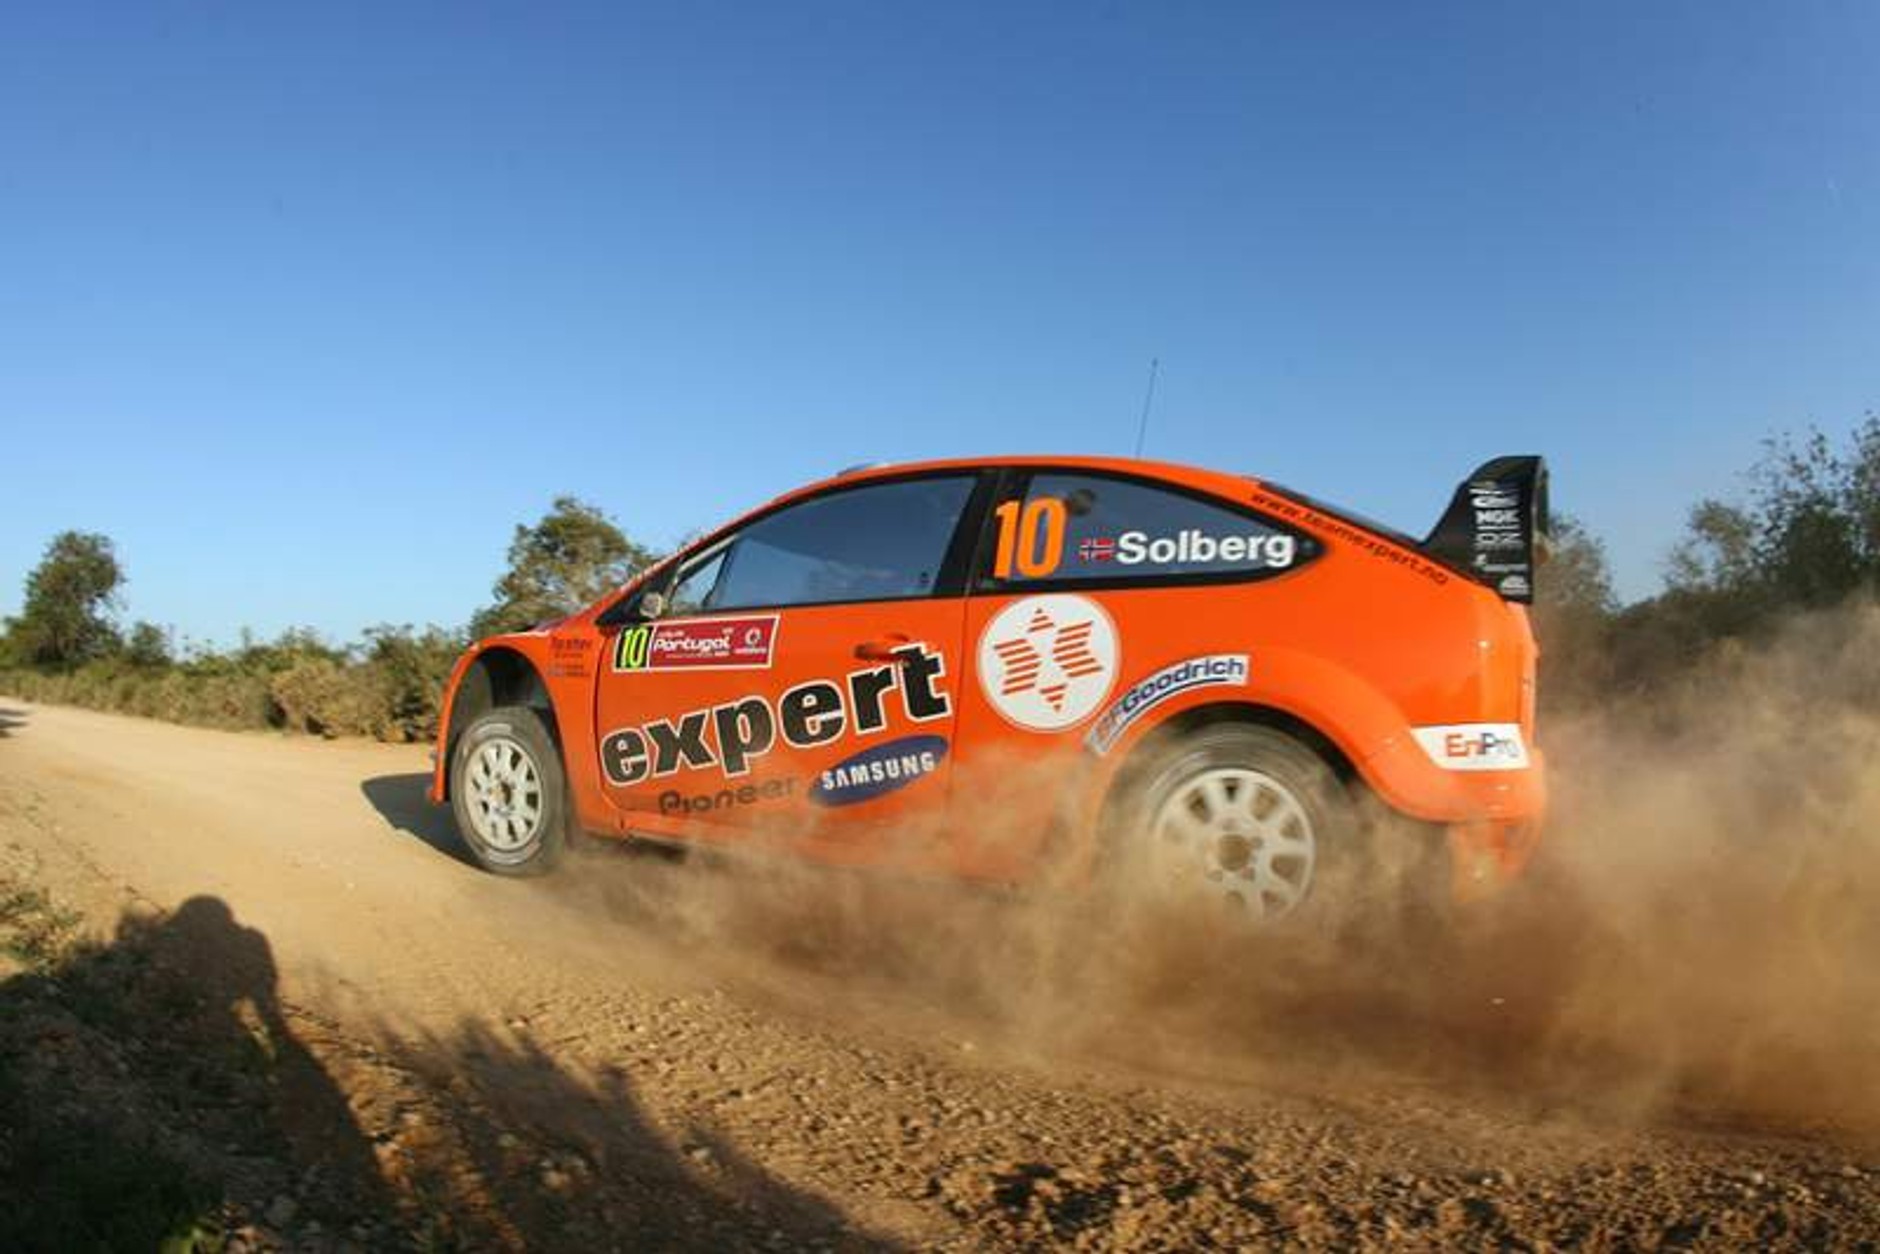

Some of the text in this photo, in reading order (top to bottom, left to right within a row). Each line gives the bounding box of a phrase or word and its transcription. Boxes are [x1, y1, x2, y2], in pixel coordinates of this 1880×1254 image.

[994, 496, 1068, 579] 10
[1115, 529, 1296, 569] Solberg
[620, 627, 649, 669] 10
[653, 636, 732, 653] Portugal
[600, 642, 952, 787] expert
[822, 751, 936, 791] SAMSUNG
[657, 774, 799, 815] Pioneer
